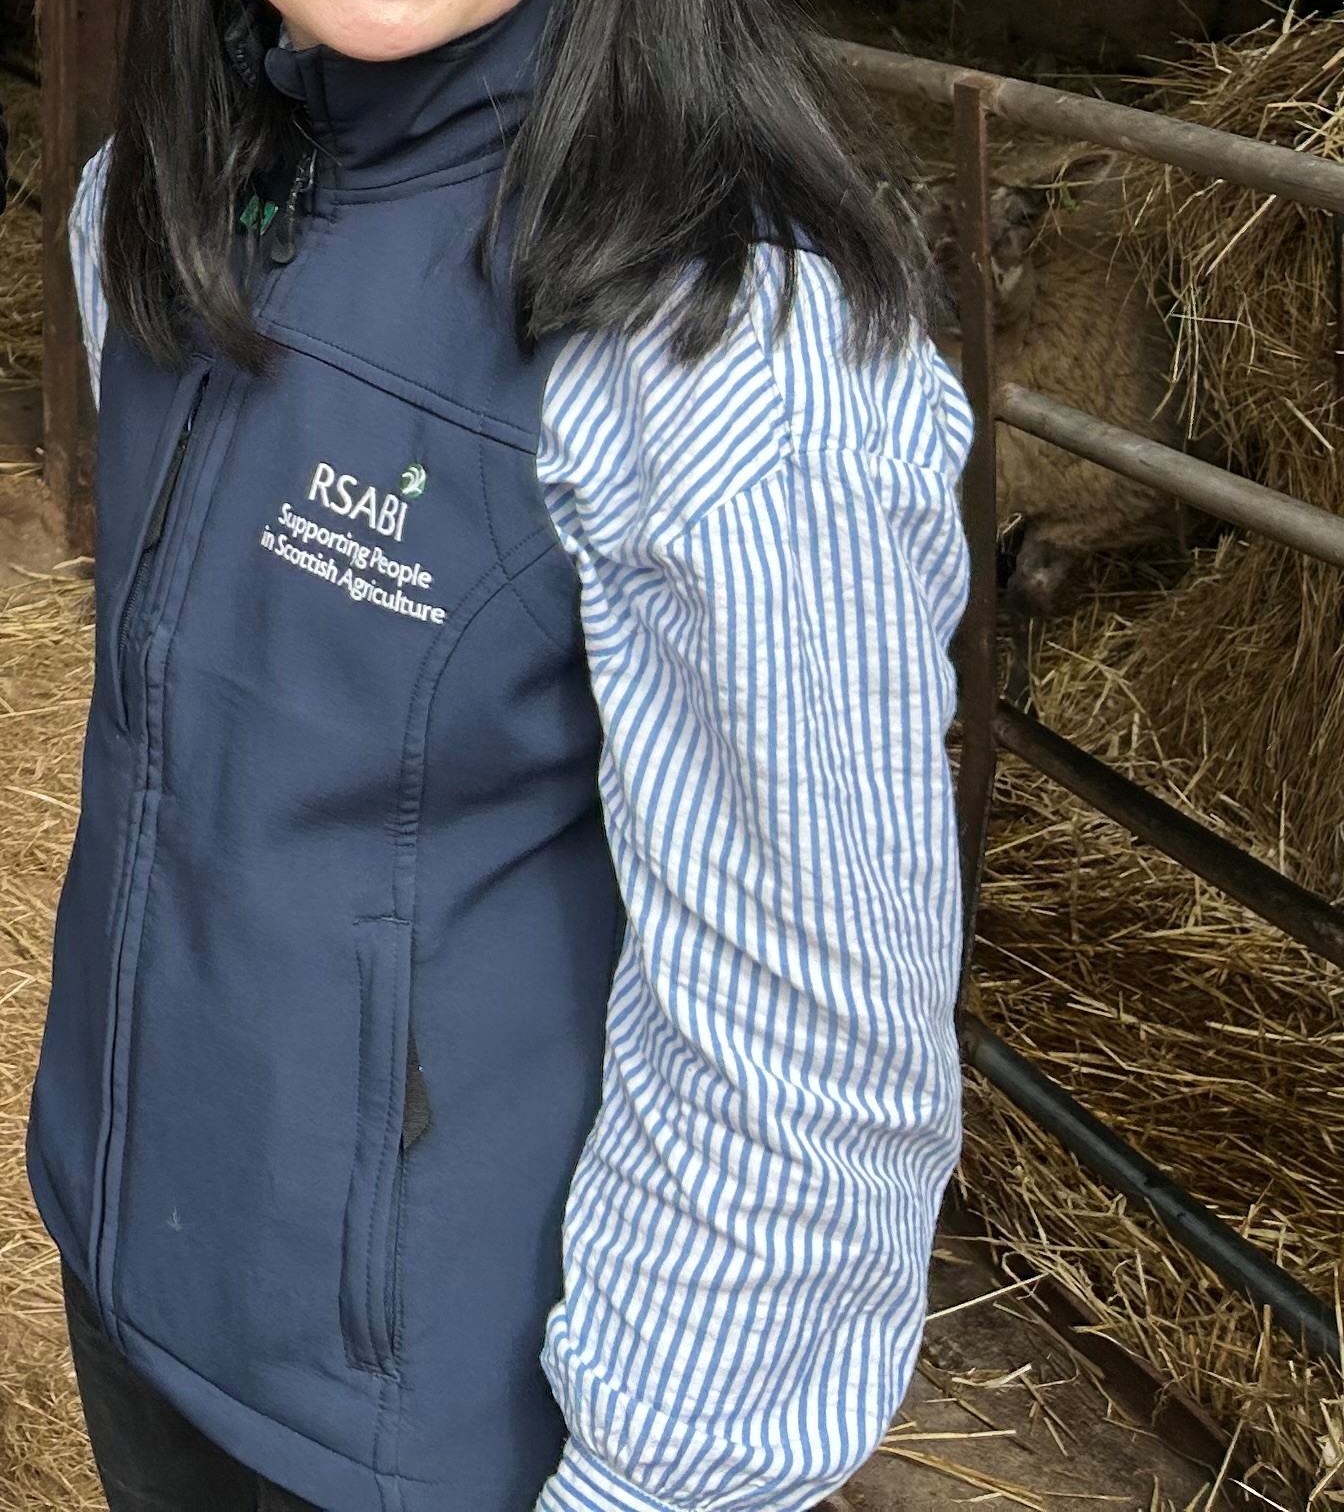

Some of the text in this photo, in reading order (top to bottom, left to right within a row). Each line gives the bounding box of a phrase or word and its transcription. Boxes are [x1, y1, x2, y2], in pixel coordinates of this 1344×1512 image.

[308, 462, 407, 541] RSABI
[260, 524, 445, 624] in Scottish Agriculture
[277, 502, 433, 589] Supporting People
